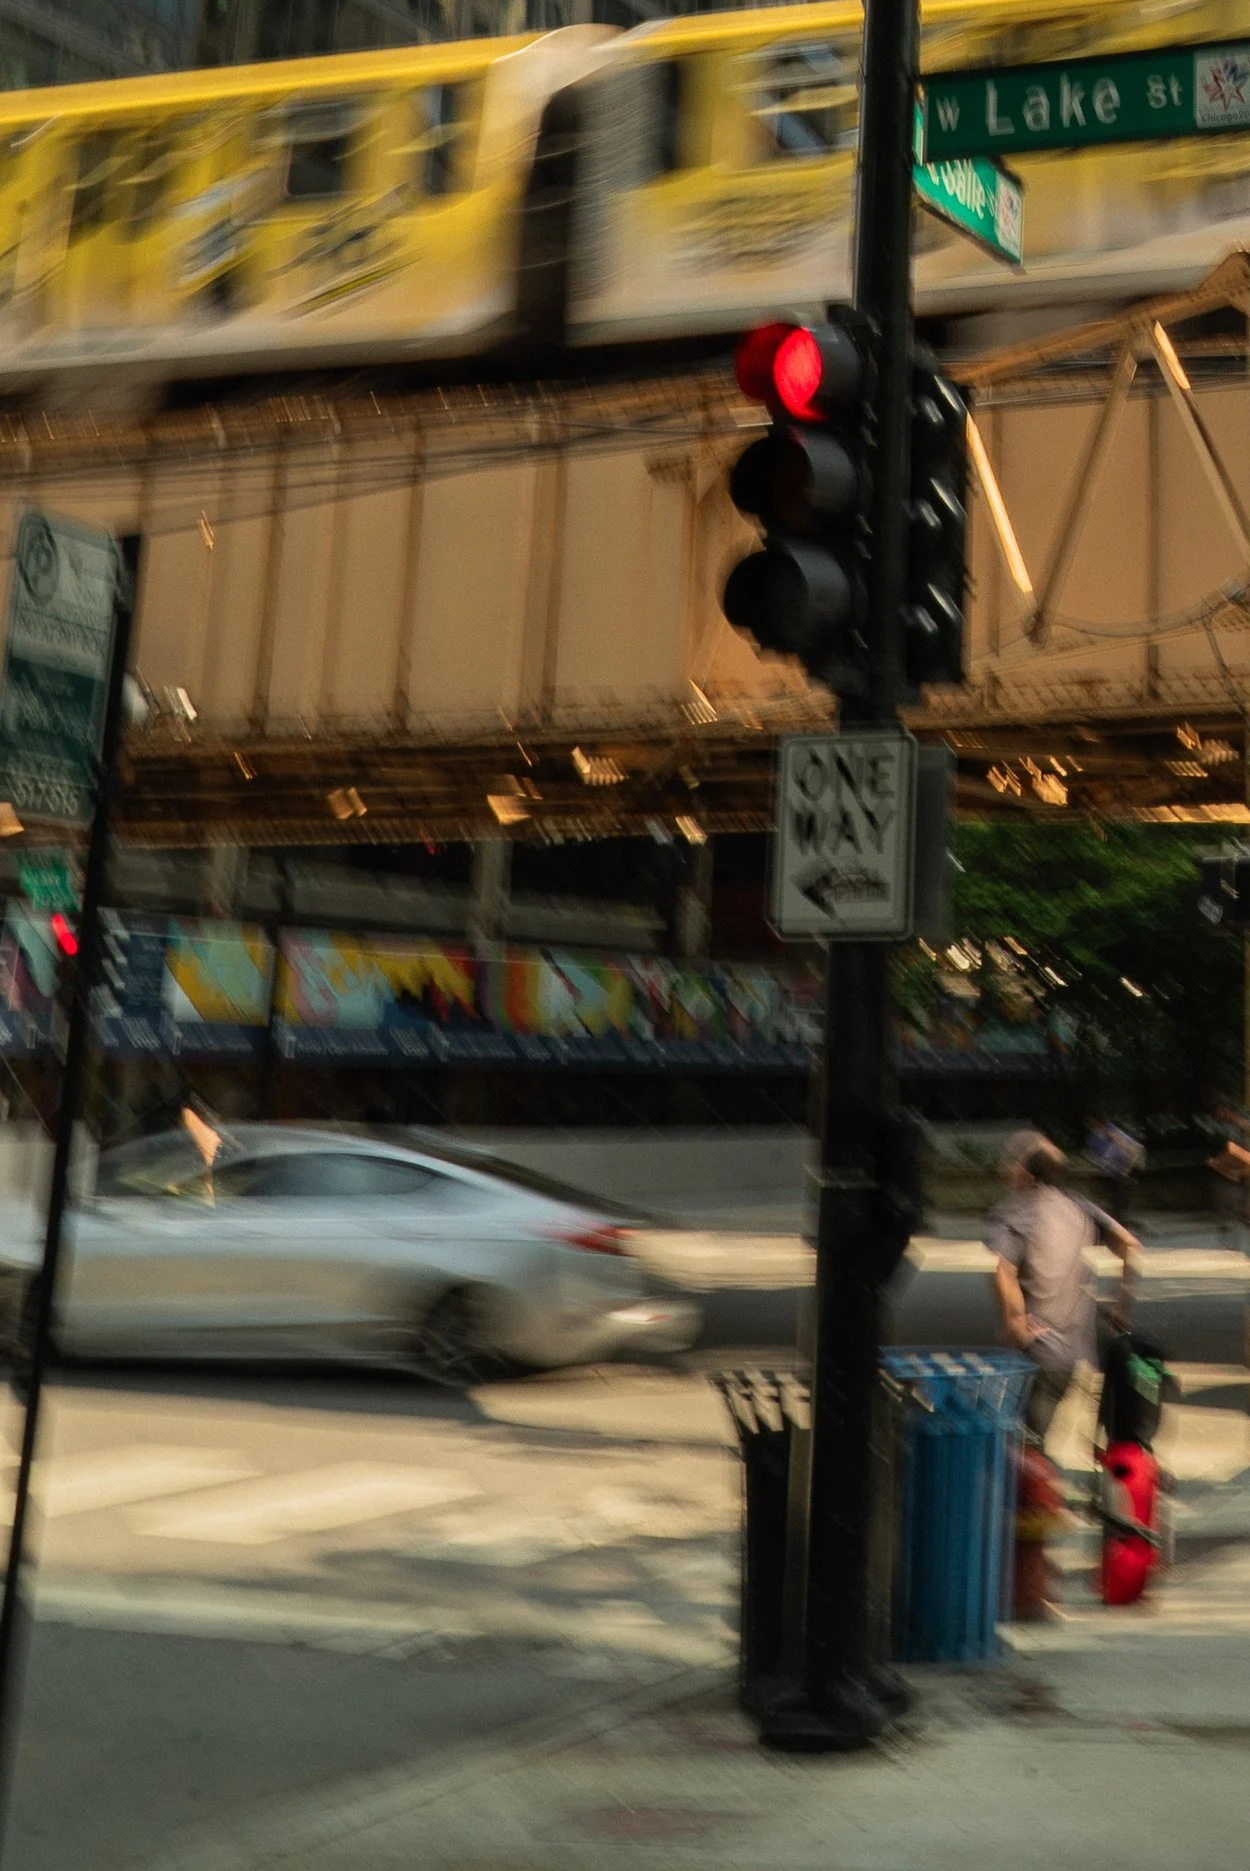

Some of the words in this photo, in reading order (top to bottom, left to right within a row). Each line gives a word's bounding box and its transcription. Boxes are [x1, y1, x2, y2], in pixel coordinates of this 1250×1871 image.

[986, 71, 1120, 136] Lake
[797, 748, 897, 802] ONE
[794, 809, 898, 855] WAY
